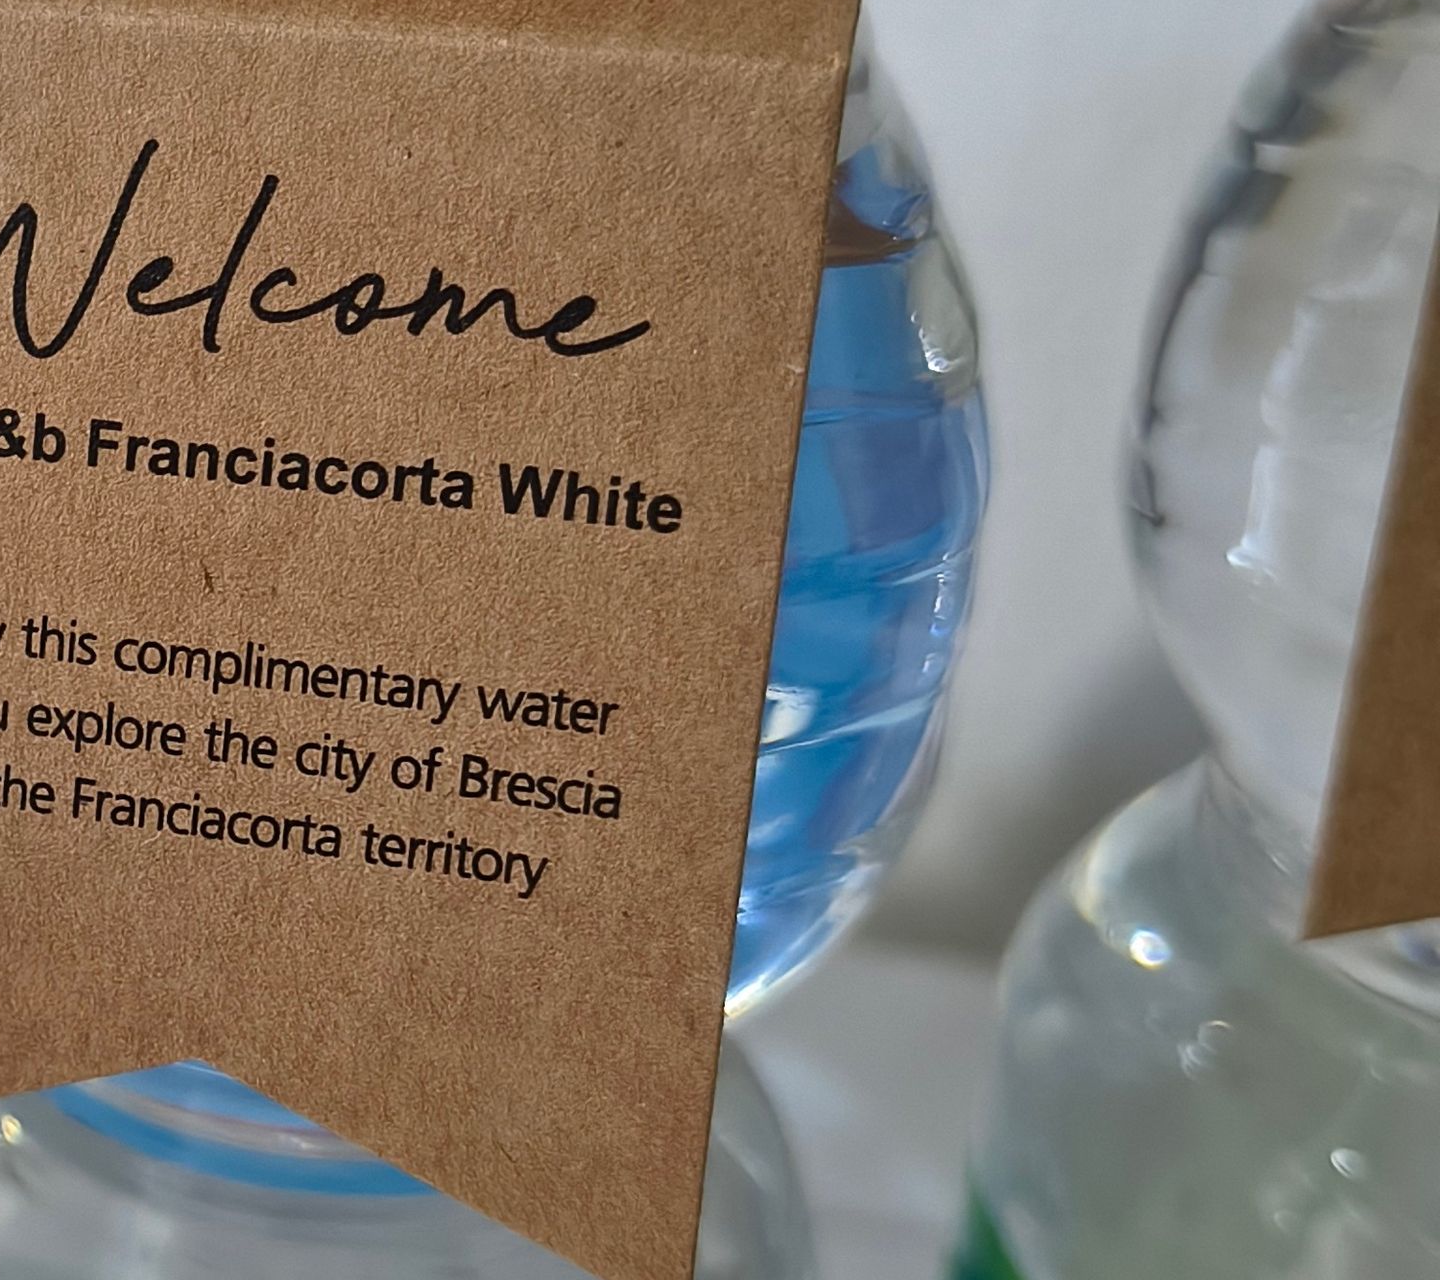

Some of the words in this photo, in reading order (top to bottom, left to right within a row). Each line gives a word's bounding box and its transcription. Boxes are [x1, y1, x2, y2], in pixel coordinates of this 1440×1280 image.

[86, 418, 476, 510] Franciacorta
[498, 462, 683, 534] White
[20, 614, 98, 667] this
[113, 638, 463, 726] complimentary
[476, 685, 621, 736] water
[25, 701, 188, 757] explore
[203, 717, 279, 771] the
[294, 732, 377, 794] city
[390, 745, 445, 793] of
[458, 753, 623, 820] Brescia
[71, 775, 343, 859] Franciacorta
[359, 823, 550, 900] territory
